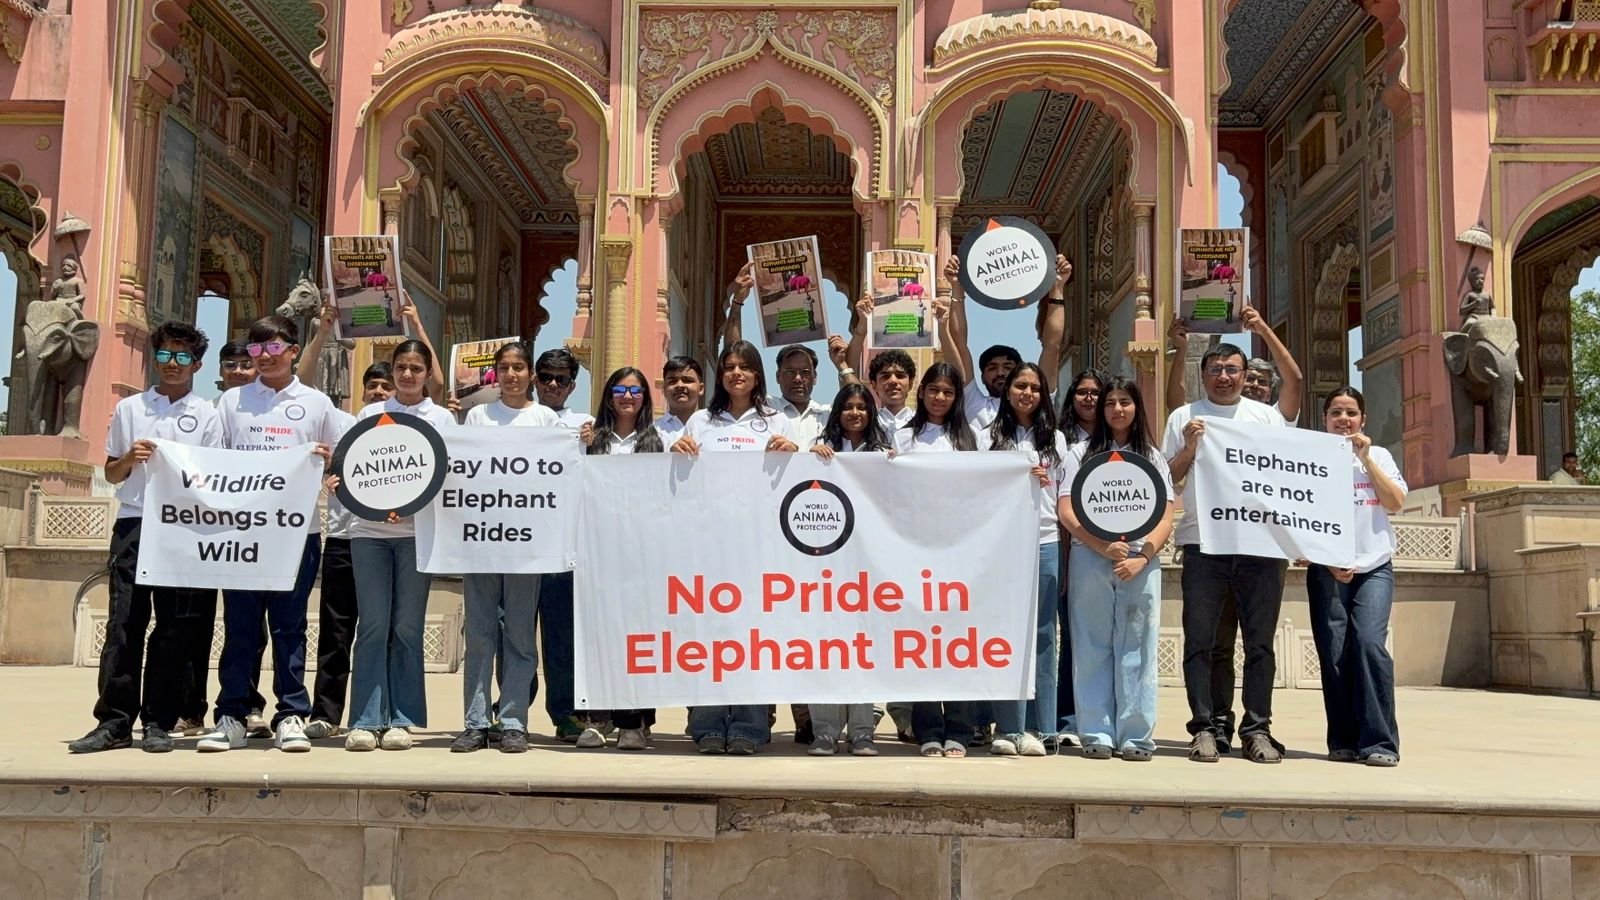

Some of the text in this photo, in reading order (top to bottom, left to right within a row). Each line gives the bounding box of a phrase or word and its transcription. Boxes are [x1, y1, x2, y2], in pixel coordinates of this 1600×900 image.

[986, 242, 1018, 257] WORLD
[976, 248, 1040, 278] ANIMAL
[984, 263, 1039, 286] PROTECTION
[265, 426, 293, 435] PRIDE
[731, 436, 756, 444] PRIDE
[369, 444, 407, 456] WORLD
[351, 453, 428, 478] ANIMAL
[490, 456, 530, 475] NO
[537, 458, 564, 476] to
[1225, 447, 1328, 478] Elephants
[181, 469, 286, 493] Wildlife
[358, 472, 422, 489] PROTECTION
[1102, 479, 1133, 487] WORLD
[1241, 480, 1314, 504] are not
[442, 488, 557, 513] Elephant
[1087, 488, 1150, 504] ANIMAL
[161, 504, 305, 531] Belongs to
[792, 511, 842, 522] ANIMAL
[1093, 504, 1146, 514] PROTECTION
[463, 521, 533, 542] Rides
[1210, 506, 1342, 536] entertainers
[197, 540, 259, 563] Wild
[667, 568, 970, 616] No Pride in
[625, 625, 1014, 683] Elephant Ride
